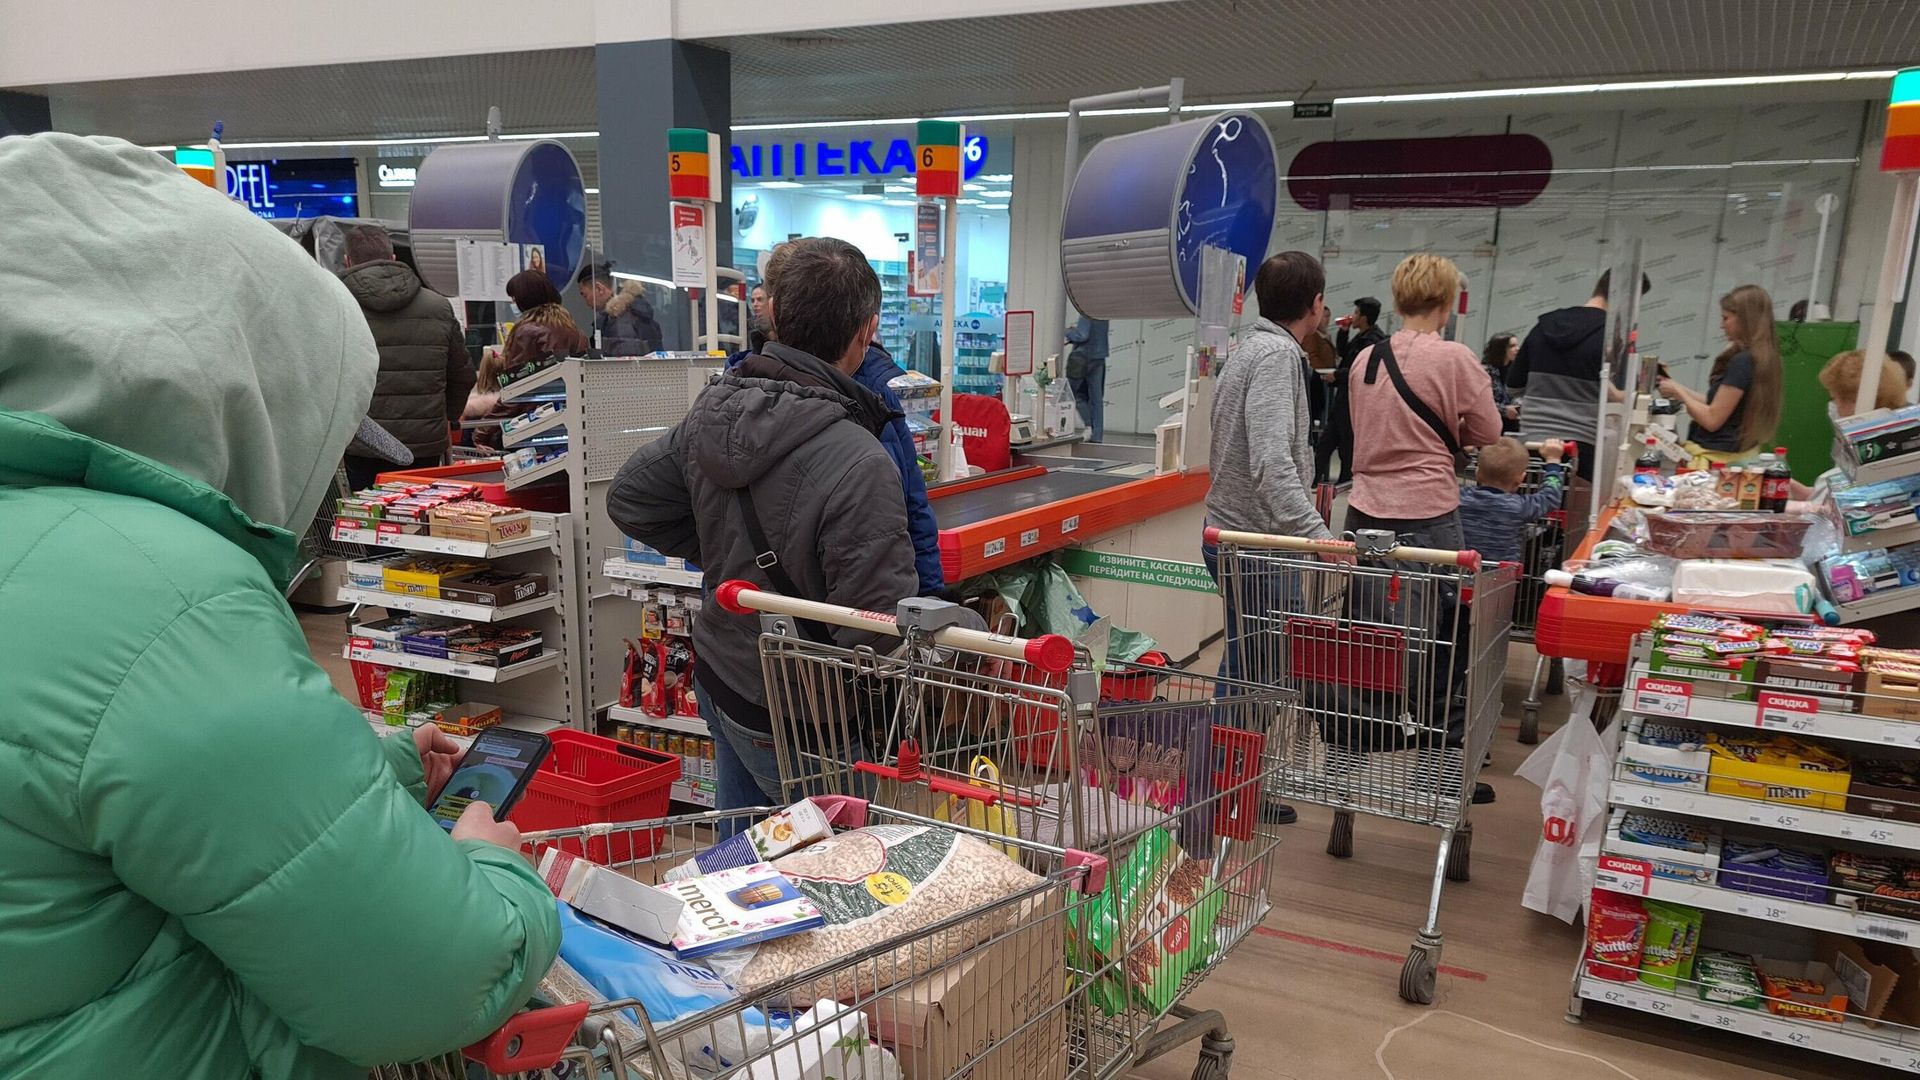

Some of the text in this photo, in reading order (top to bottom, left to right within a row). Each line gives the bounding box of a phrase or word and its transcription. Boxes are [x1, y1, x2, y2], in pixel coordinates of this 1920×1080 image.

[671, 155, 681, 172] 5
[922, 148, 933, 167] 6
[1099, 554, 1149, 570] ИЗВИНИТЕ,
[1150, 563, 1180, 573] КАССА
[1182, 566, 1194, 574] НЕ
[1089, 565, 1140, 579] ПЕРЕЙДИТЕ
[1142, 572, 1155, 581] НА
[1645, 682, 1684, 694] СКИДКА
[1767, 697, 1809, 709] СКИДКА
[1607, 860, 1644, 872] СКИДКА
[677, 883, 729, 931] merci
[742, 932, 763, 943] merci
[1595, 940, 1640, 954] Skittles
[1777, 1002, 1827, 1016] MELLER
